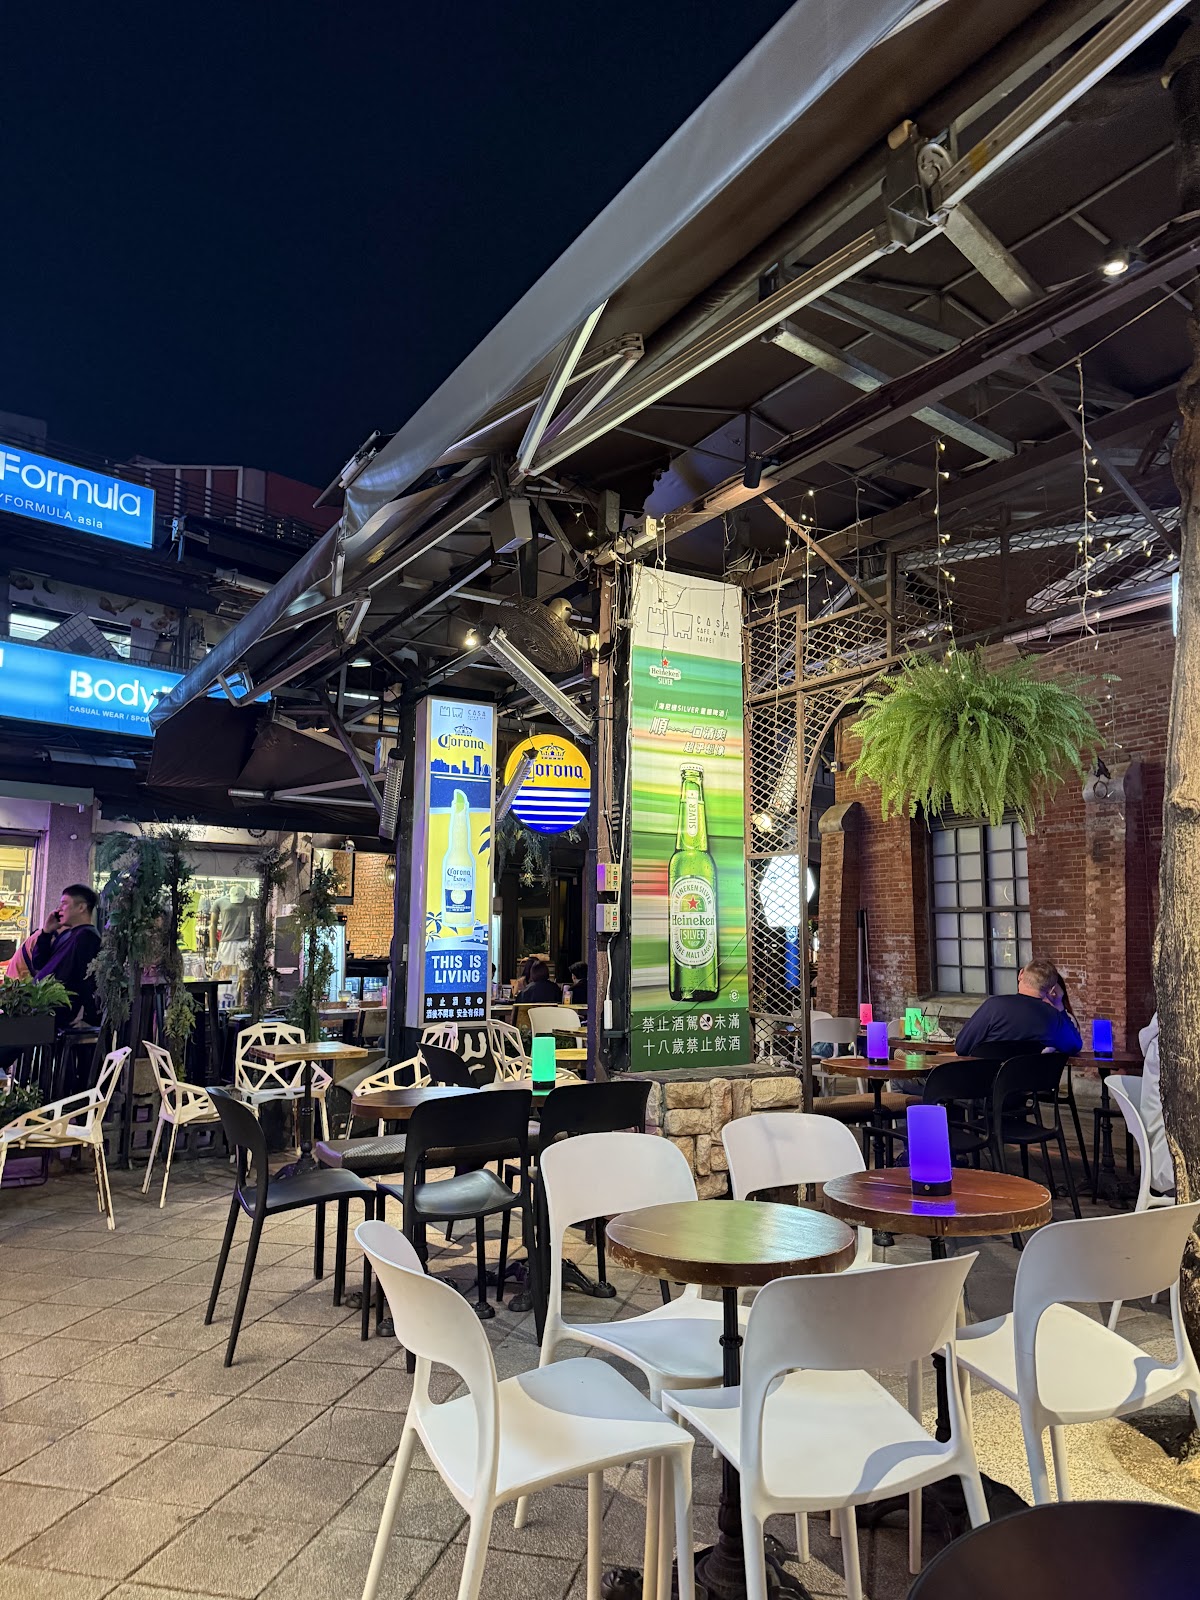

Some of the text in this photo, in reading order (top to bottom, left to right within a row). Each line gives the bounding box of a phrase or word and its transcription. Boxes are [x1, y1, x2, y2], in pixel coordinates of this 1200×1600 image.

[0, 450, 141, 517] Formula
[0, 493, 103, 529] FORMULA.asia
[697, 615, 730, 630] CASA
[651, 667, 681, 678] Heineken
[69, 705, 101, 717] CASUAL
[102, 710, 125, 720] WEAR
[437, 733, 486, 751] Corona
[688, 803, 697, 830] SILVER
[671, 914, 715, 926] Heineken
[682, 929, 705, 941] SILVER
[431, 954, 482, 969] THIS IS
[685, 951, 700, 959] MALT
[434, 969, 480, 983] LIVING
[642, 1013, 740, 1034] 禁止酒駕 未滿
[642, 1035, 741, 1057] 十八歲禁止飲酒
